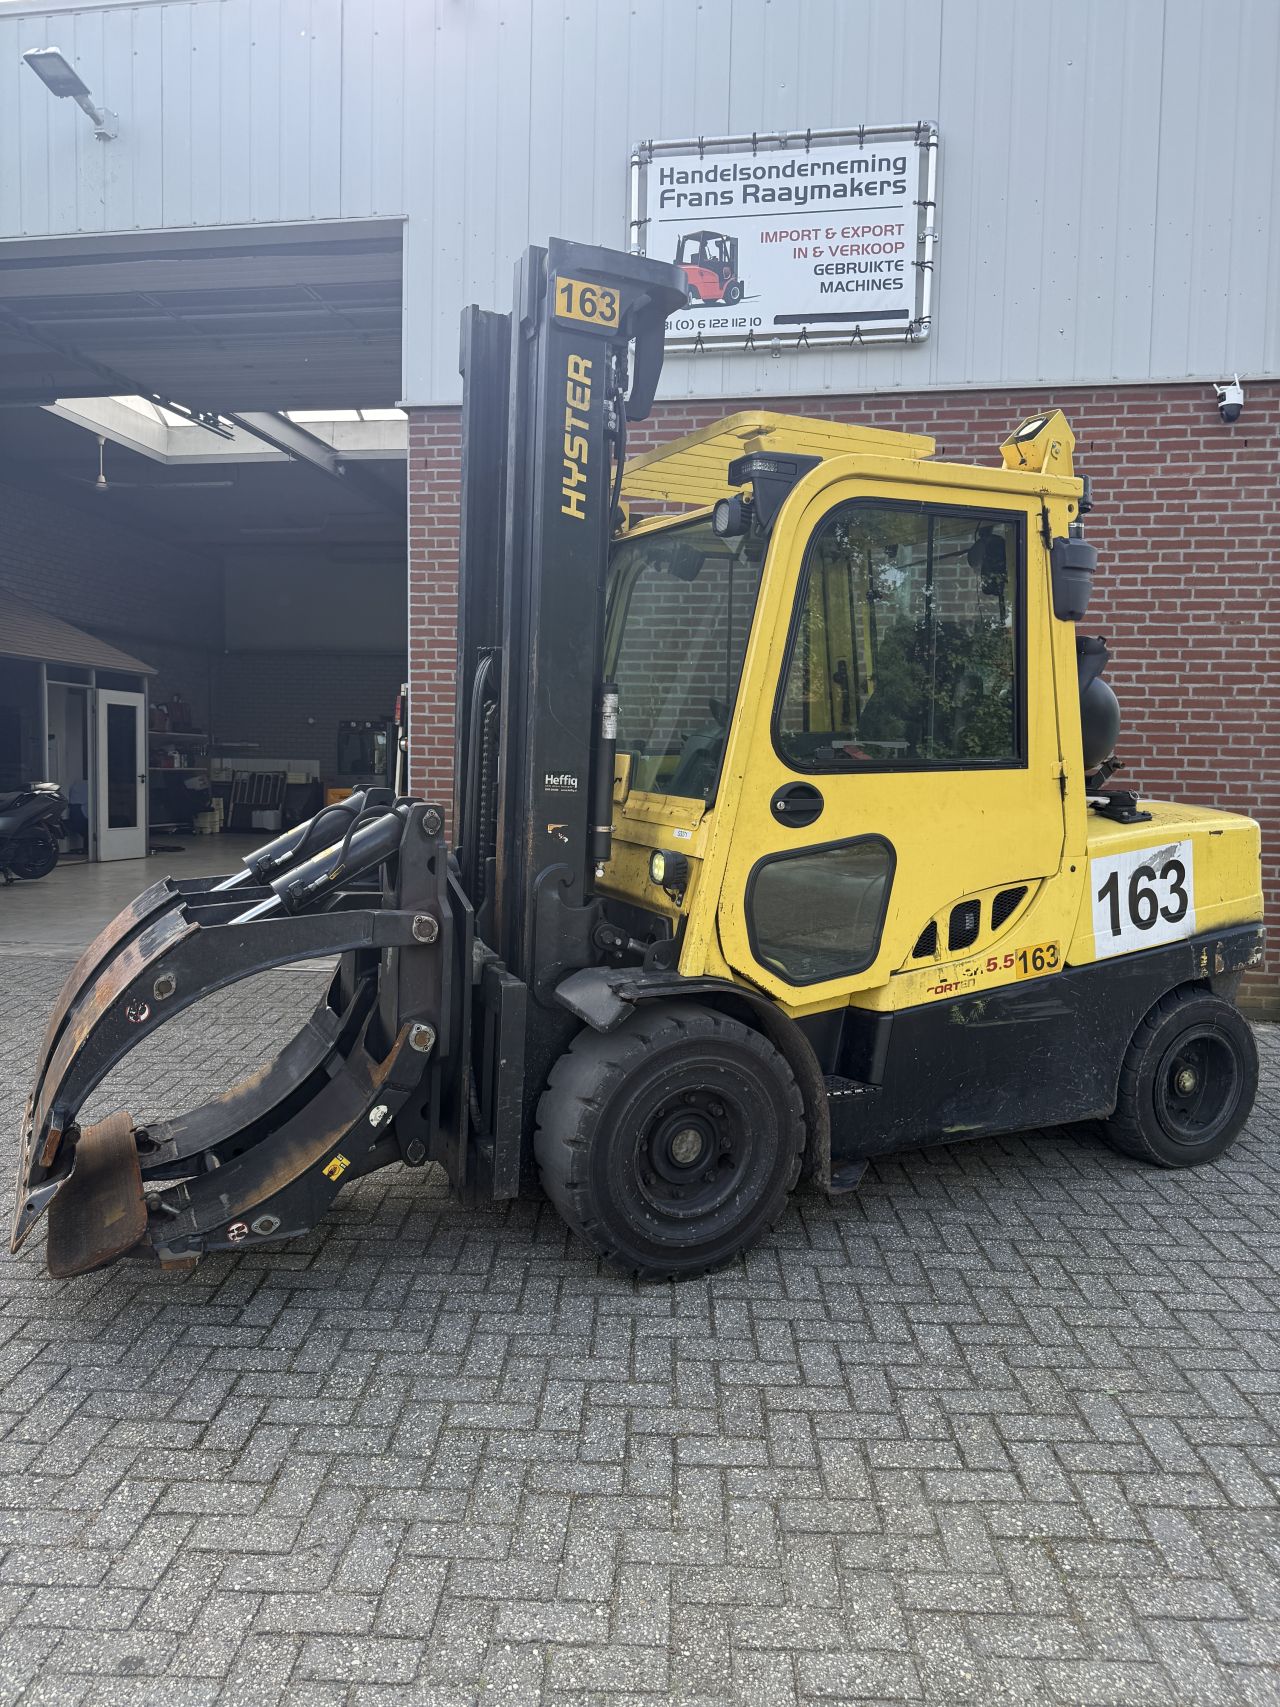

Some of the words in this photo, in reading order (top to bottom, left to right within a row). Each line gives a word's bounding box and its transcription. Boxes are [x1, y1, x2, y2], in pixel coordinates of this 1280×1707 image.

[659, 154, 907, 186] Handelsonderneming
[659, 188, 734, 209] Frans
[742, 177, 907, 206] Raaymakers
[760, 228, 822, 244] IMPORT
[825, 228, 837, 240] &
[841, 223, 905, 239] EXPORT
[793, 246, 808, 260] IN
[812, 246, 825, 258] &
[828, 241, 905, 258] VERKOOP
[813, 259, 905, 276] GEBRUIKTE
[820, 277, 904, 294] MACHINES
[559, 282, 617, 322] 163
[697, 319, 706, 329] 6
[709, 318, 729, 329] 122
[731, 317, 747, 328] 112
[749, 316, 762, 327] 10
[561, 353, 593, 520] HYSTER
[1096, 858, 1189, 937] 163
[986, 953, 1015, 974] 5.5
[1018, 944, 1060, 975] 163
